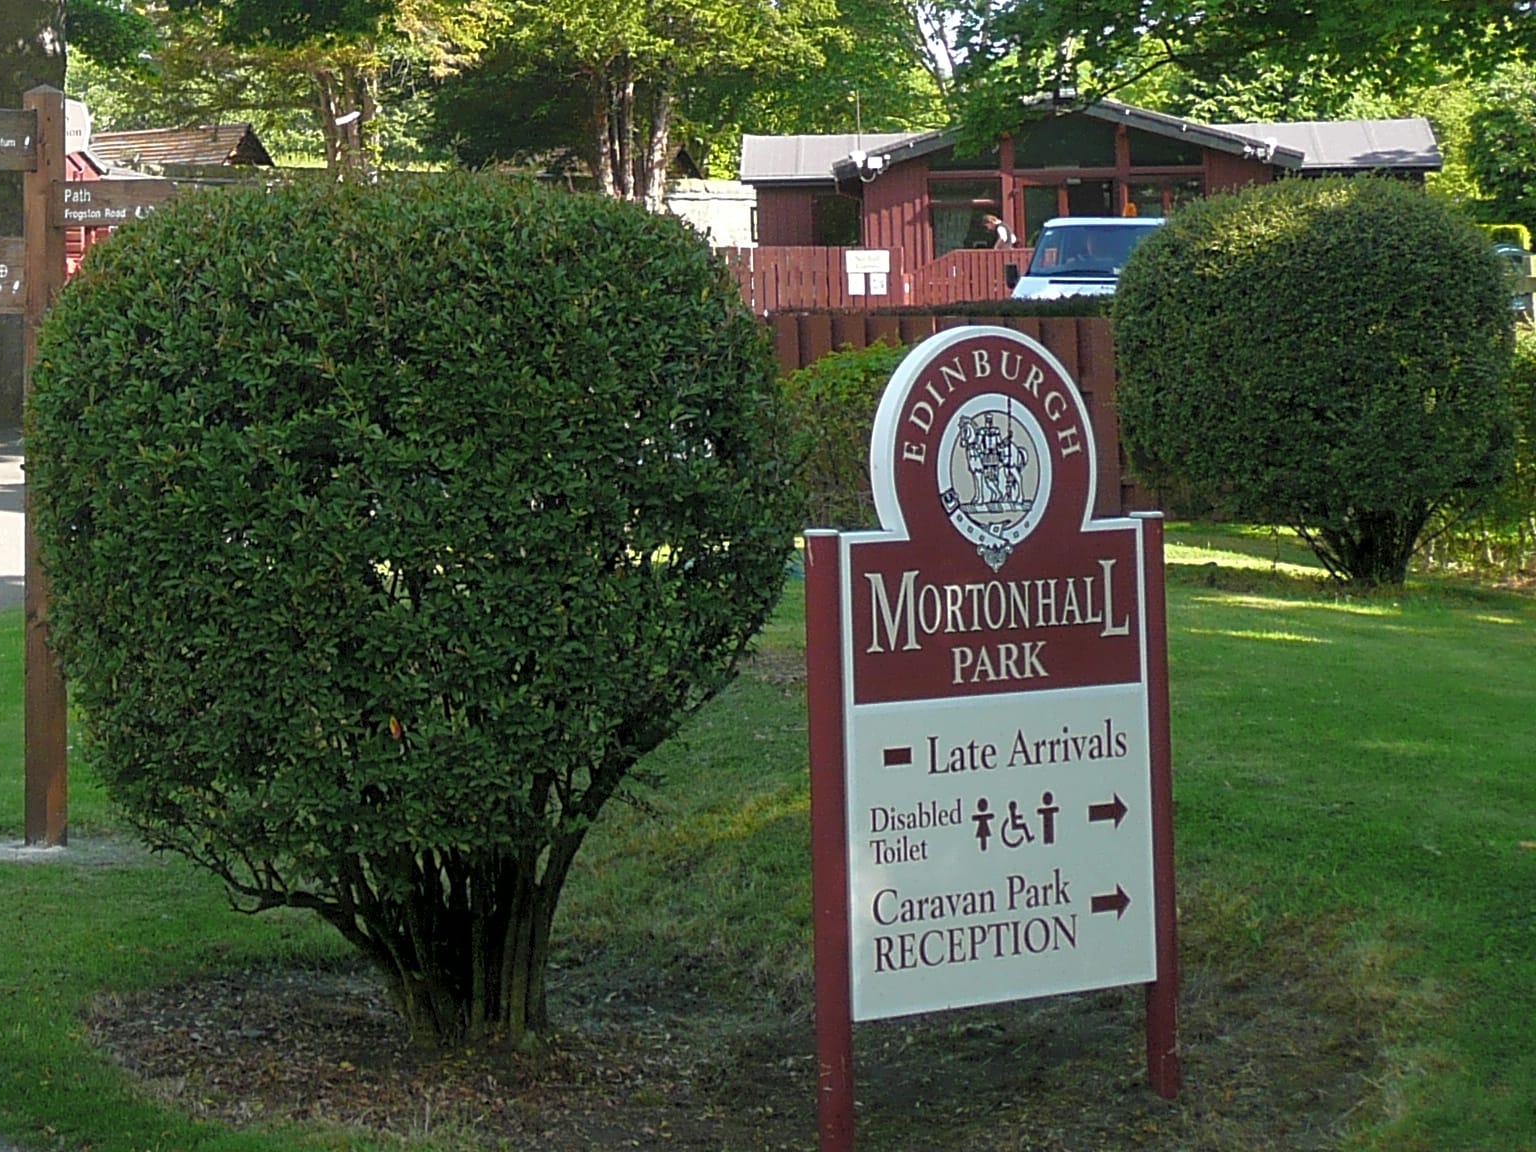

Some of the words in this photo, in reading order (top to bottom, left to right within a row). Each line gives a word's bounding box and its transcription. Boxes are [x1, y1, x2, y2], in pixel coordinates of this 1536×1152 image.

[64, 188, 91, 203] Path
[64, 208, 101, 221] Frogston
[104, 208, 126, 218] Road
[902, 349, 1082, 465] EDINBURGH
[864, 559, 1131, 654] MORTONHALL
[951, 641, 1049, 685] PARK
[927, 736, 997, 775] Late
[1007, 719, 1128, 767] Arrivals
[870, 798, 963, 833] Disabled
[870, 836, 928, 865] Toilet
[872, 888, 996, 926] Caravan
[1006, 868, 1071, 911] Park
[873, 914, 1078, 974] RECEPTION
